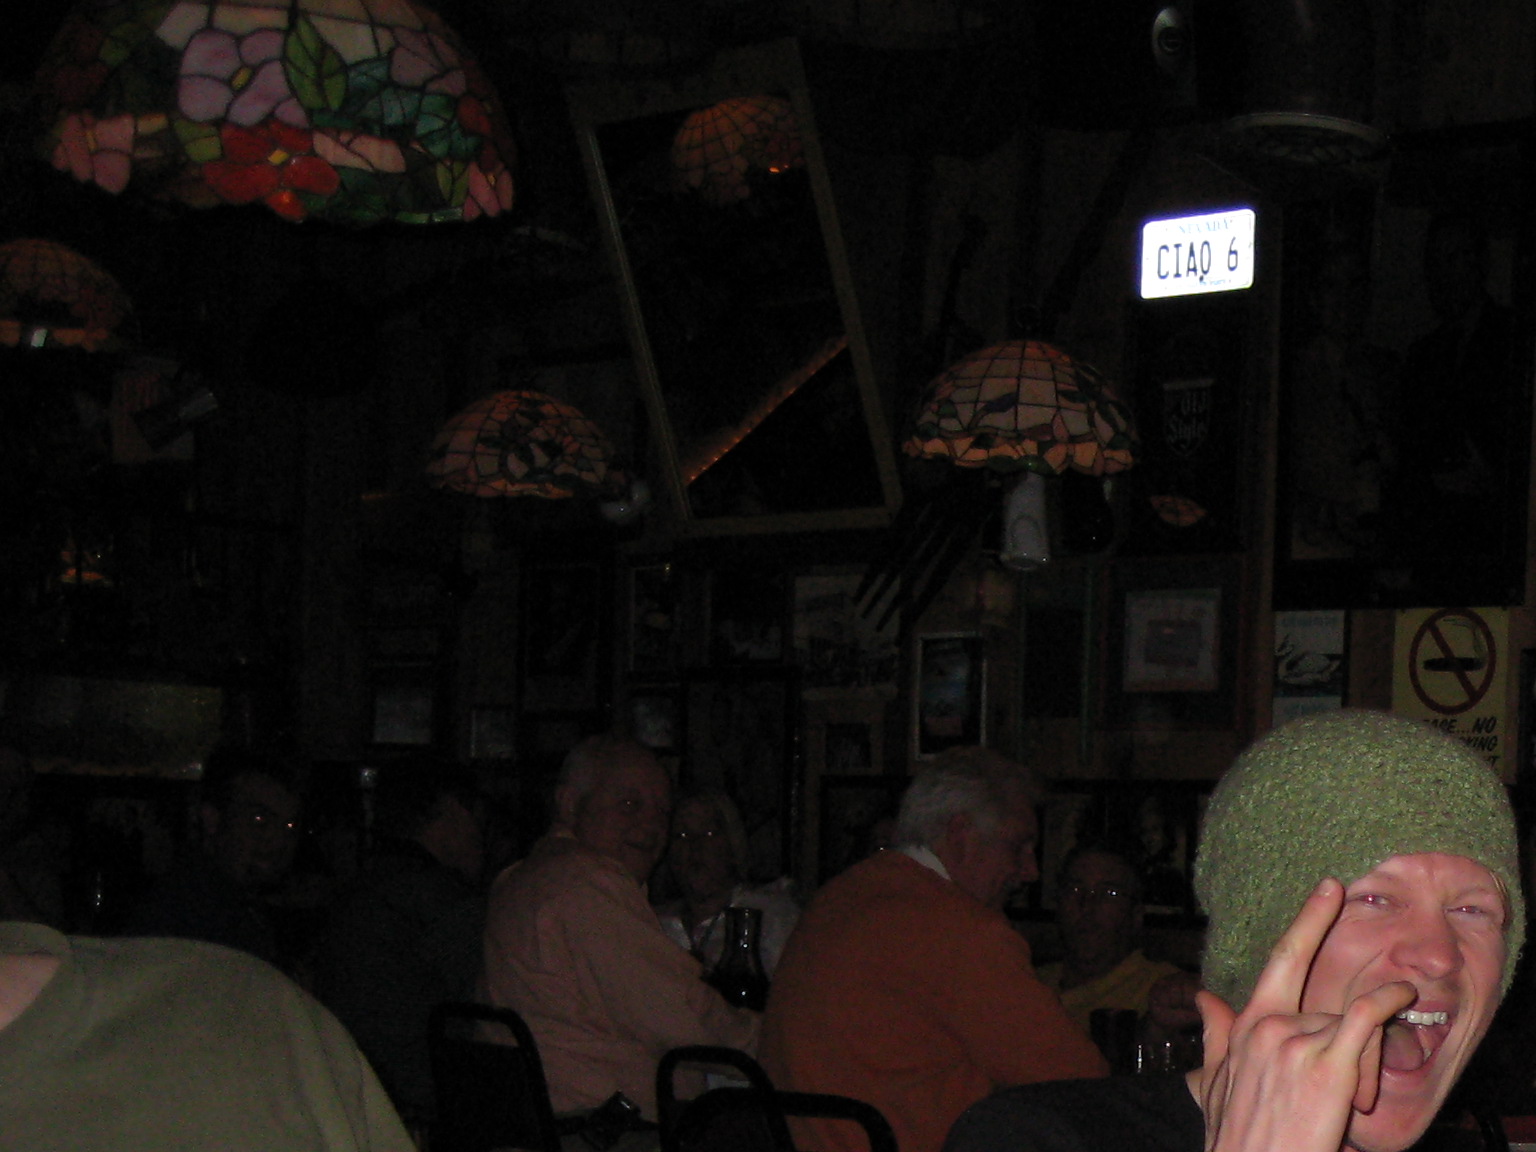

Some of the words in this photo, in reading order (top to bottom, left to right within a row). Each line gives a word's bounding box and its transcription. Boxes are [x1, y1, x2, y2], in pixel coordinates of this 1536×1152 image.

[1157, 240, 1211, 280] CIAO
[1227, 236, 1239, 272] 6
[1472, 716, 1498, 734] NO
